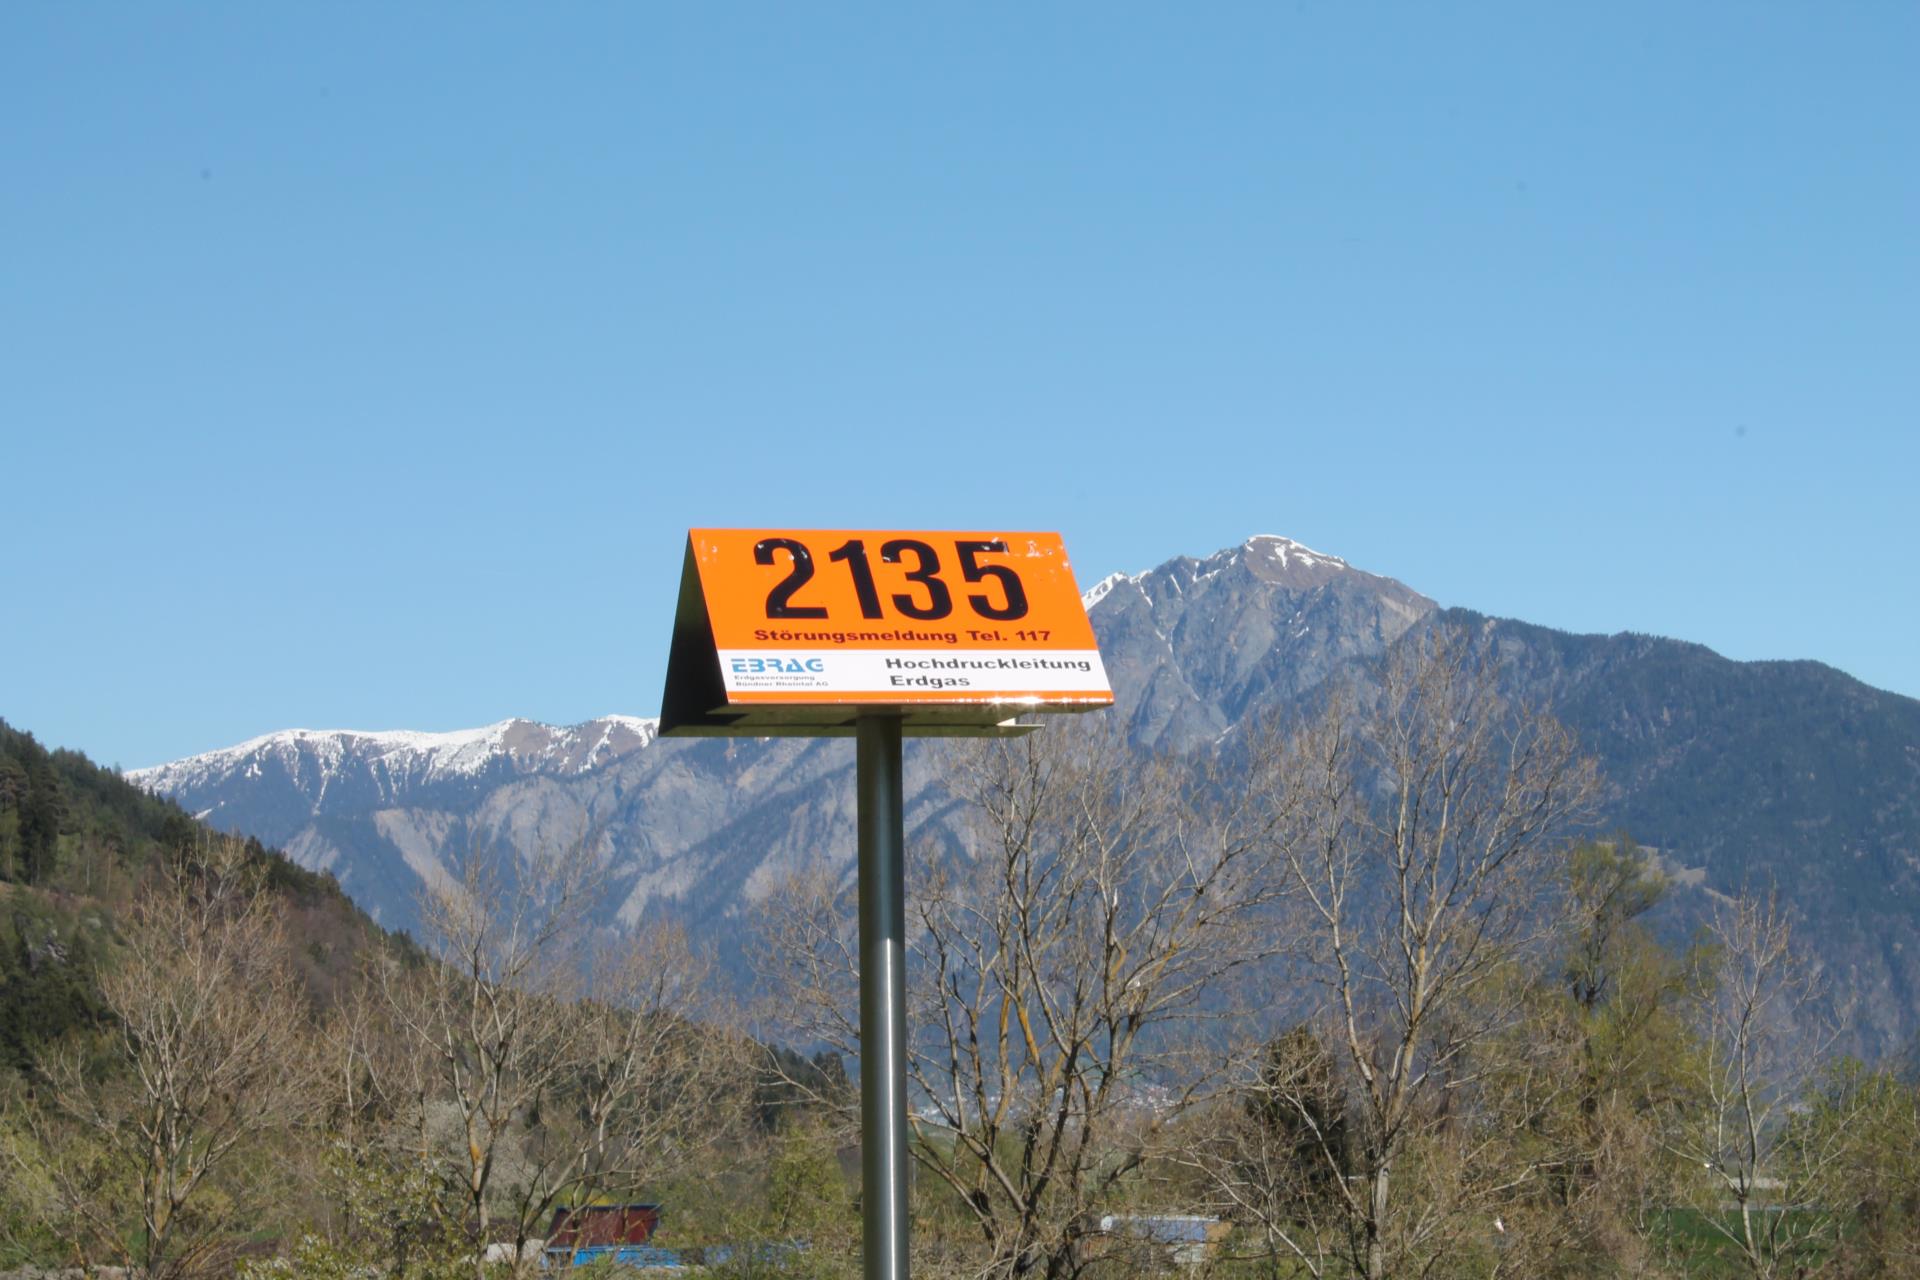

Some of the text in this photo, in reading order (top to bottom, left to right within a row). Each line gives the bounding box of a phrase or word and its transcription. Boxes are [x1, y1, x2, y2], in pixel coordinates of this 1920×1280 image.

[753, 538, 1028, 621] 2135
[754, 629, 1052, 644] Störungsmeldung Tel. 117
[731, 658, 825, 673] EBRAG
[885, 658, 1092, 672] Hochdruckleitung
[890, 675, 971, 688] Erdgas
